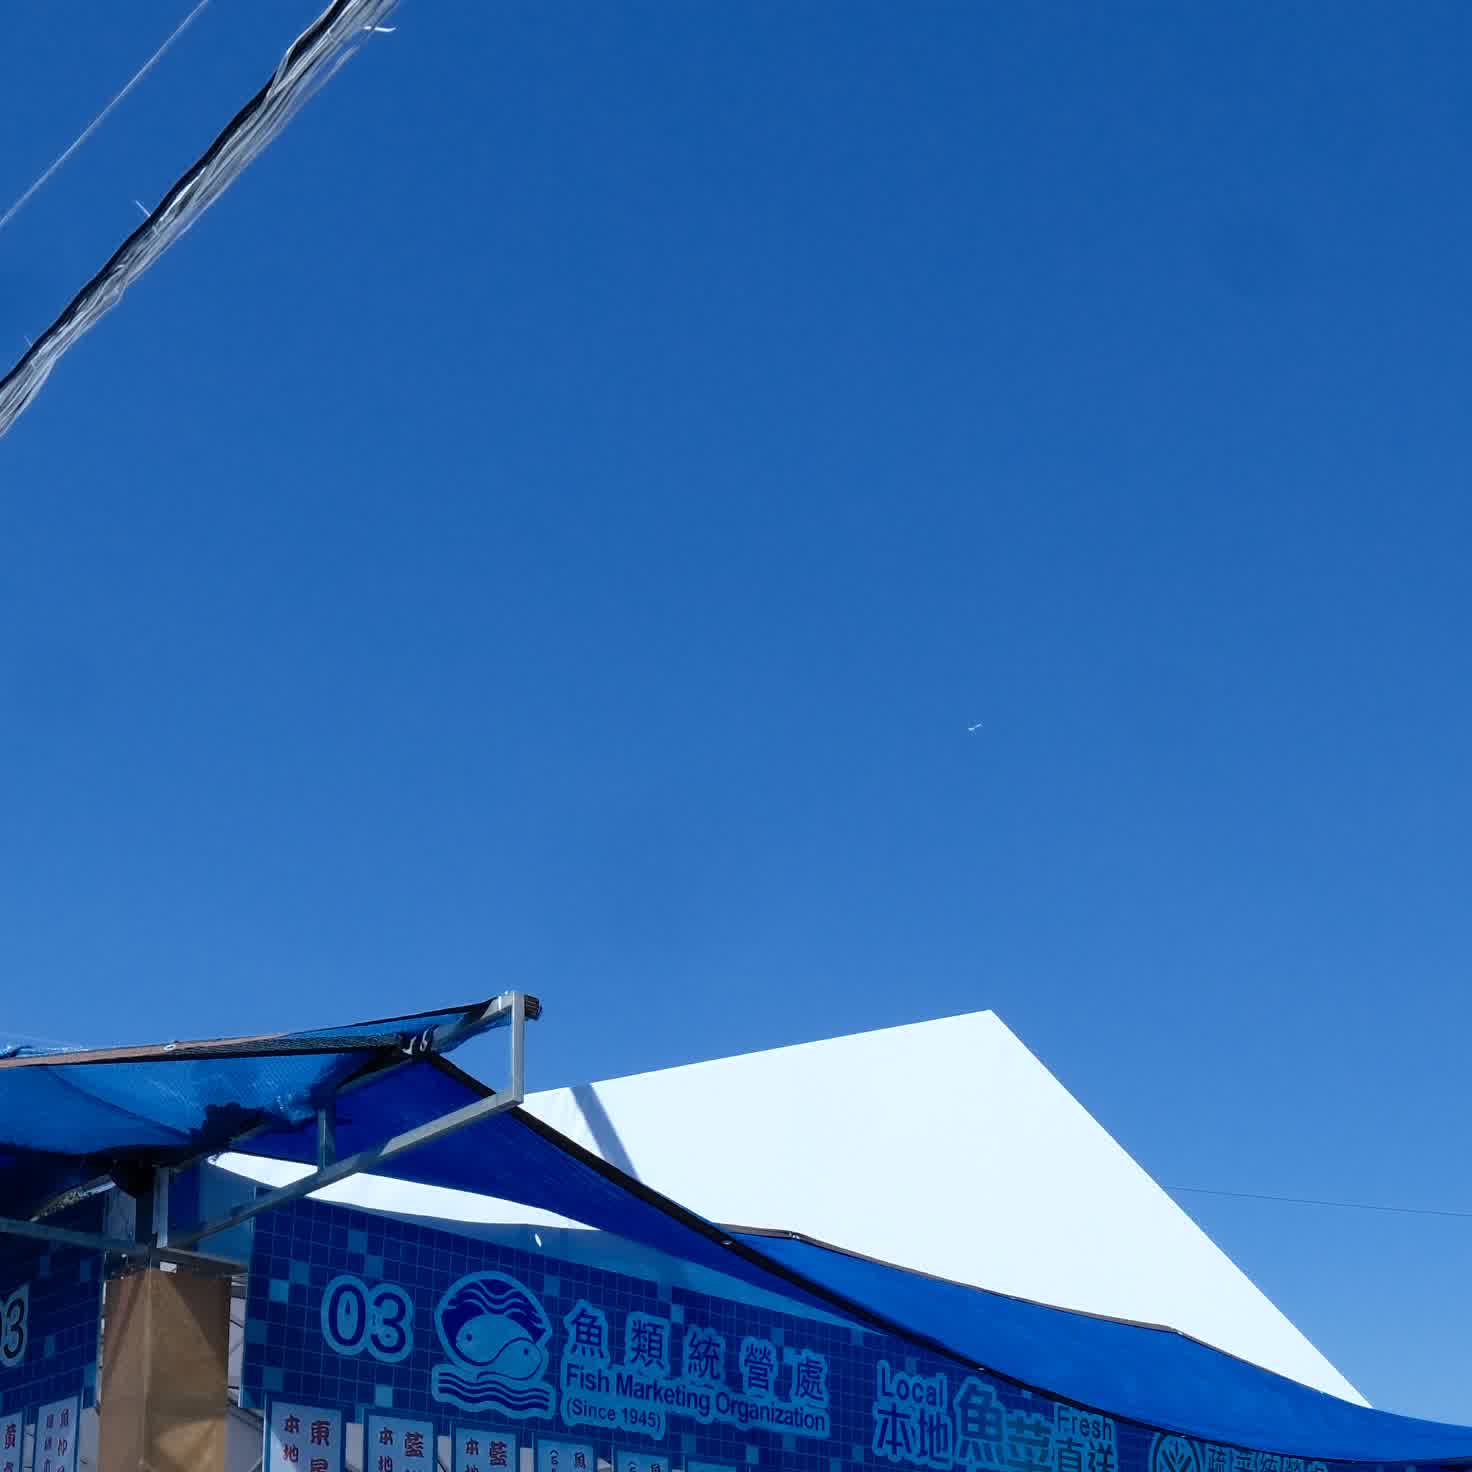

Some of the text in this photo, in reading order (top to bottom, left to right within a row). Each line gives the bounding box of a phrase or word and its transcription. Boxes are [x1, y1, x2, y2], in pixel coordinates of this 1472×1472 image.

[327, 1283, 410, 1356] 03
[569, 1312, 826, 1402] 魚類統營處
[565, 1362, 827, 1433] Fish Marketing Organization
[880, 1365, 946, 1406] Local
[565, 1394, 665, 1434] (Since 1945)
[1058, 1403, 1113, 1441] Fresh
